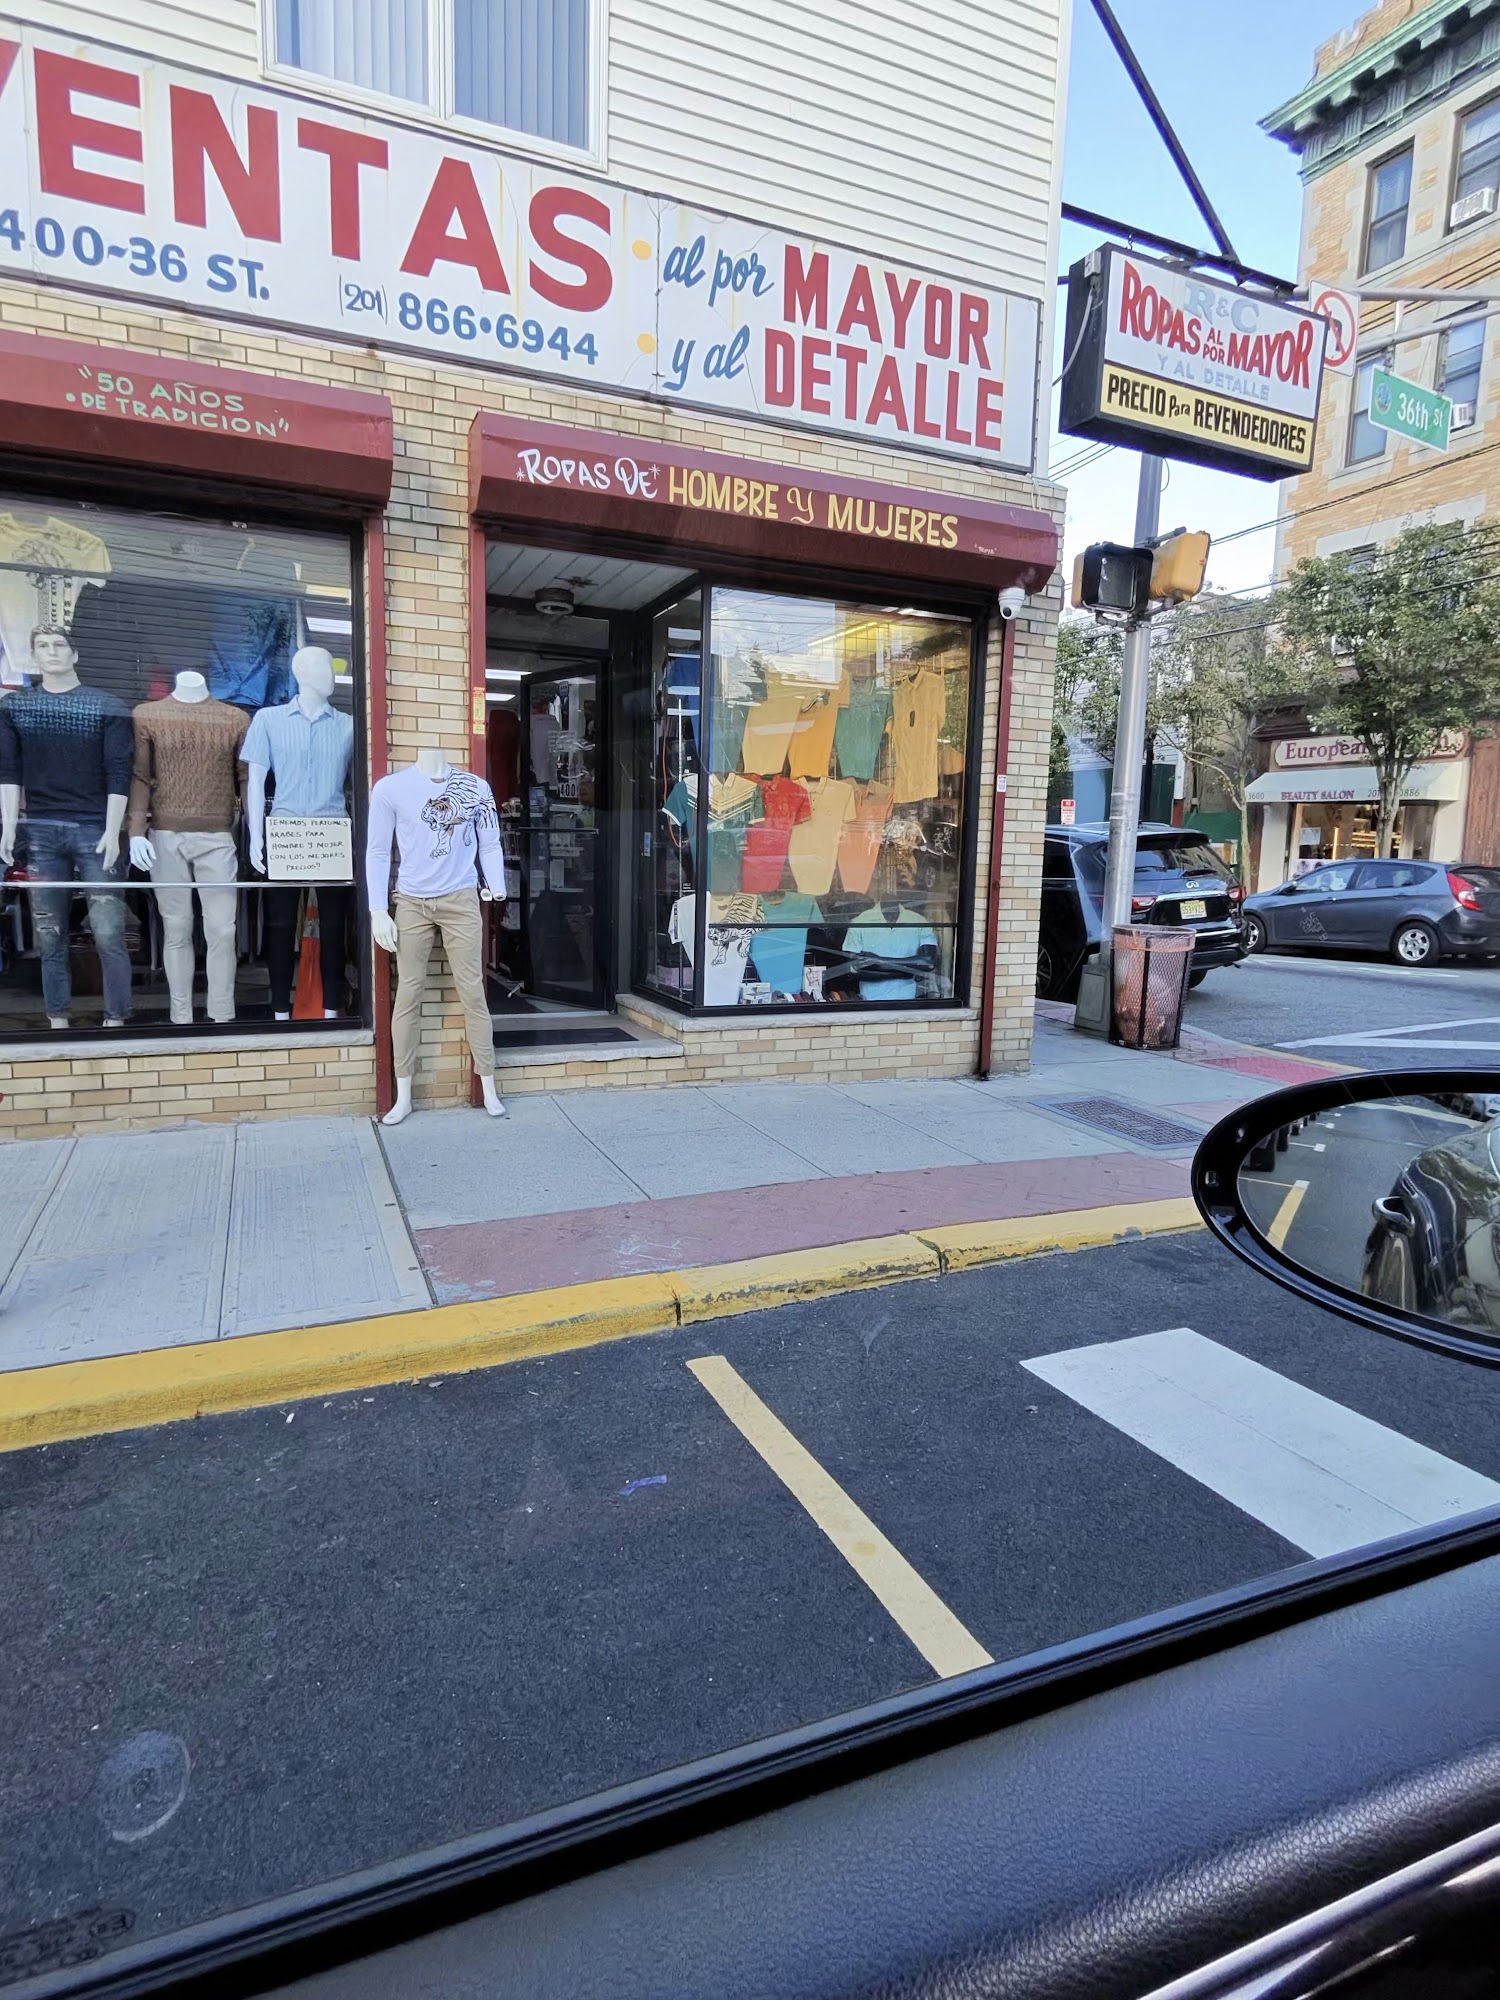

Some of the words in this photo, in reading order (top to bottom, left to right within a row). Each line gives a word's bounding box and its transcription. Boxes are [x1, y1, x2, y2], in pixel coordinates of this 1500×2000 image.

[0, 40, 613, 313] ENTAS
[206, 253, 270, 301] ST.
[338, 273, 388, 325] (201)
[663, 234, 705, 288] al
[708, 248, 775, 307] por
[783, 243, 991, 371] MAYOR
[1119, 260, 1202, 355] ROPAS
[1206, 327, 1224, 346] AL
[1227, 319, 1314, 389] MAYOR
[1158, 353, 1169, 371] Y
[1174, 360, 1195, 380] AL
[1204, 366, 1270, 401] DETALLE
[1203, 343, 1225, 365] POR
[81, 392, 106, 411] DE
[150, 382, 244, 412] AÑOS
[662, 338, 695, 391] y
[703, 325, 750, 379] al
[765, 327, 1004, 451] DETALLE
[1397, 392, 1429, 431] 36th
[1433, 408, 1443, 428] St
[1107, 373, 1166, 418] PRECIO
[1169, 394, 1190, 418] Para
[1193, 398, 1306, 454] REVENDEDORES
[517, 448, 611, 490] ROPAS
[669, 467, 779, 519] HOMBRE
[787, 485, 815, 526] Y
[827, 494, 959, 549] MUJERES
[1281, 790, 1319, 801] BEAUTY
[1321, 789, 1355, 800] SALON
[270, 819, 307, 827] TENEMOS
